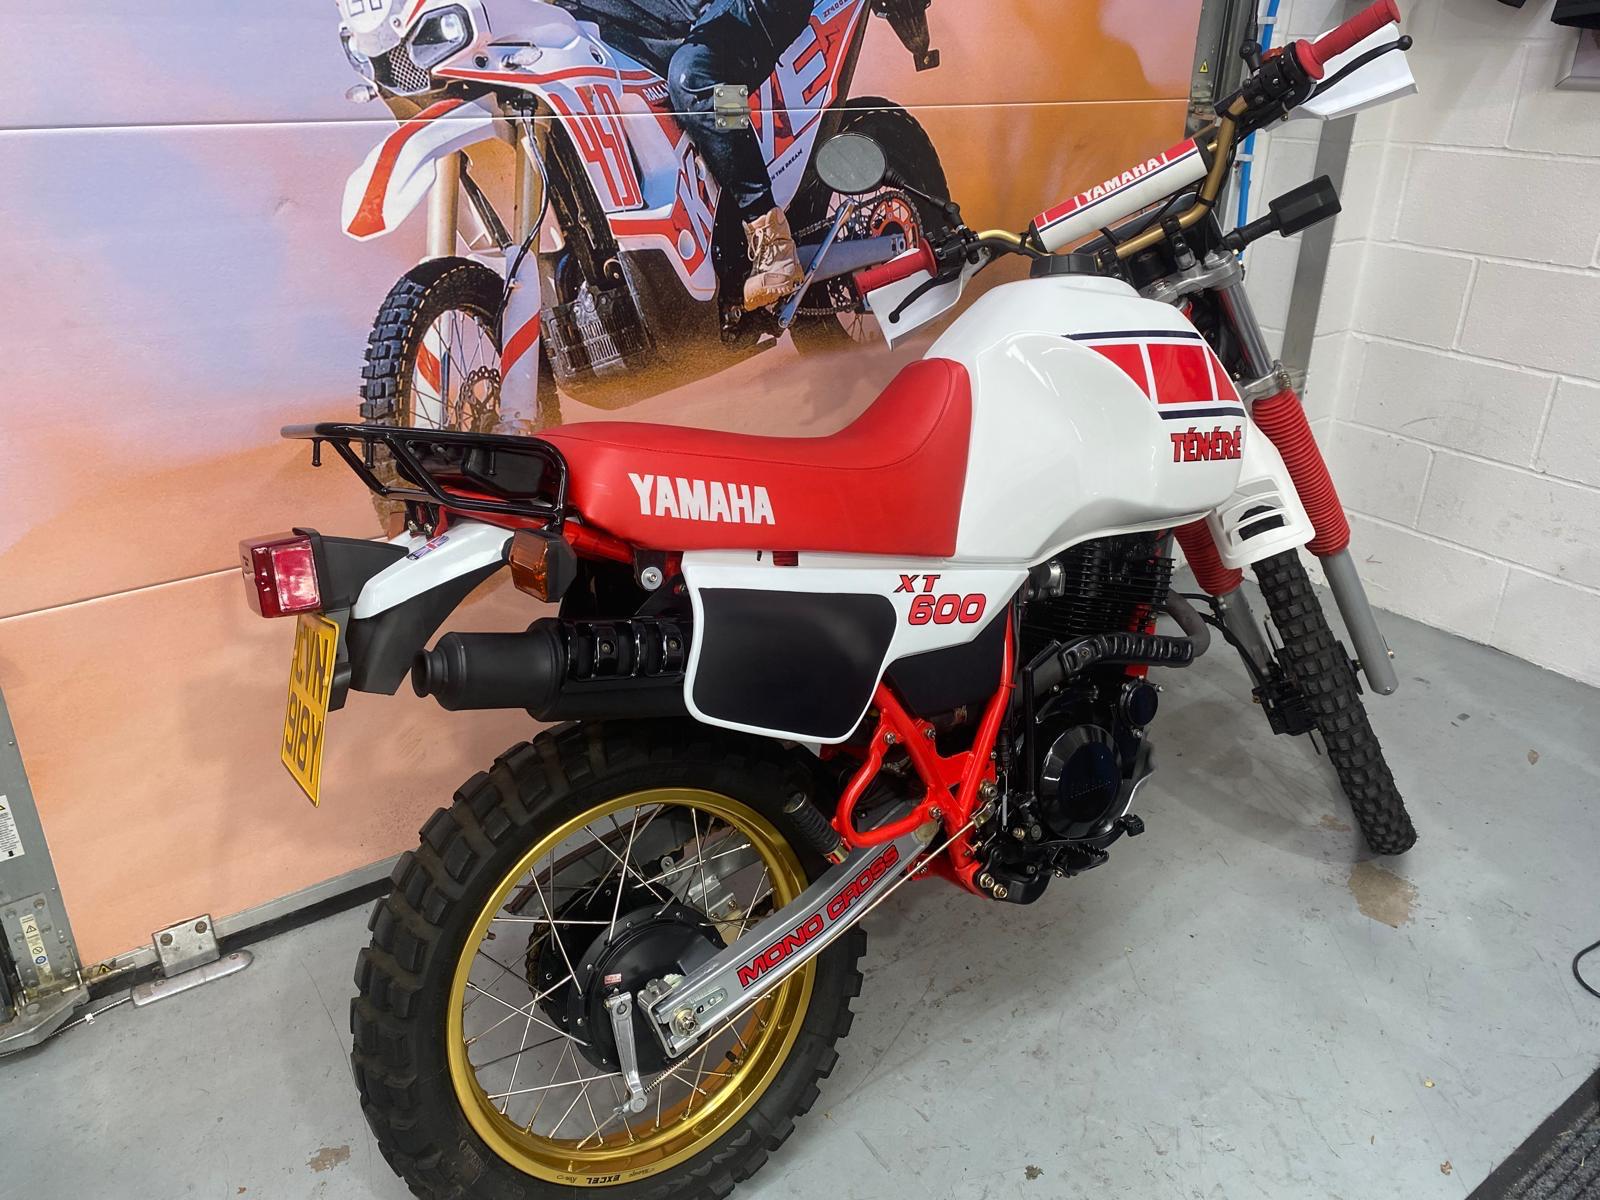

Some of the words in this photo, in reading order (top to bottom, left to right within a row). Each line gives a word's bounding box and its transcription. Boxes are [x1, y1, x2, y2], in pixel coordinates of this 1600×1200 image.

[775, 166, 785, 177] THE
[785, 148, 803, 169] DREAM
[1081, 157, 1161, 202] YAMAHA
[1170, 425, 1242, 462] TÉNÉRÉ
[627, 472, 776, 525] YAMAHA
[893, 574, 941, 593] XT
[908, 593, 987, 625] 600
[285, 691, 322, 784] 918Y
[736, 913, 825, 988] MONO
[826, 844, 900, 921] CROSS
[586, 1174, 621, 1185] EXCEL
